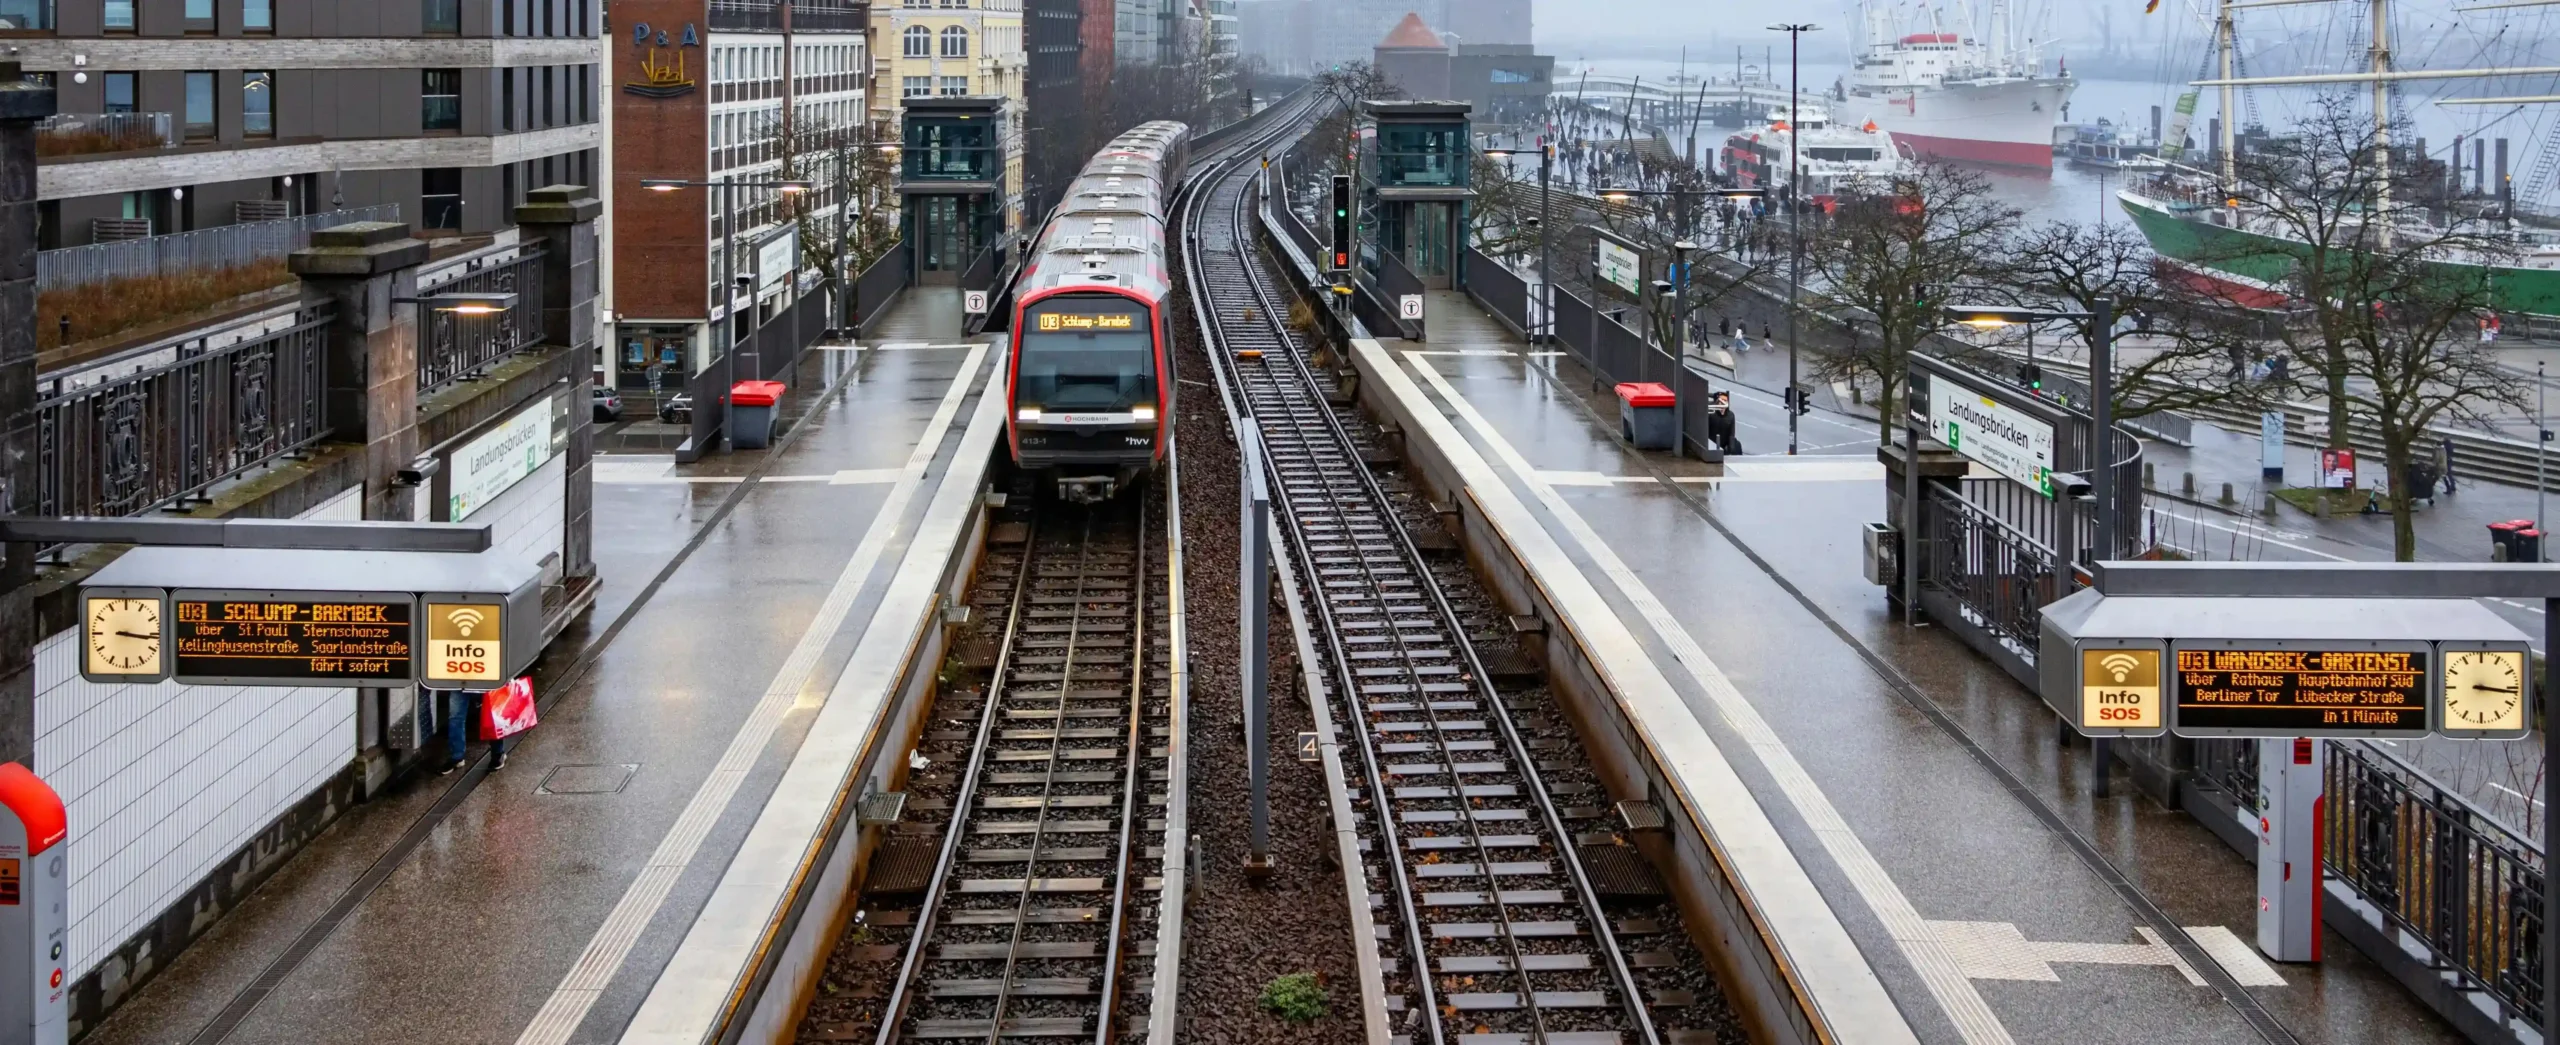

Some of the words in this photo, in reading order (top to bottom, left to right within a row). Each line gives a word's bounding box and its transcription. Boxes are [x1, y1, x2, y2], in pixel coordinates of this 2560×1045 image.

[633, 22, 651, 45] P
[656, 29, 669, 46] &
[681, 23, 699, 47] A
[1948, 395, 2029, 449] Landungsbrücken
[1022, 437, 1047, 445] 413-1
[1130, 437, 1150, 446] hvv
[470, 423, 536, 476] Landungsbrücken
[180, 604, 206, 619] U3
[303, 623, 389, 637] Sternschanze
[178, 638, 299, 653] Kellinghusenstraße
[311, 641, 408, 654] Saarlandstraße
[446, 644, 485, 658] Info
[310, 658, 343, 672] fährt
[348, 659, 389, 672] sofort
[446, 661, 485, 673] SOS
[2180, 652, 2207, 670] U3
[2231, 673, 2283, 686] Rathaus
[2099, 690, 2140, 704] Info
[2196, 689, 2252, 702] Berliner
[2257, 690, 2280, 702] Tor
[2295, 690, 2356, 703] Lübecker
[2360, 691, 2405, 704] Straße
[2099, 707, 2141, 720] SOS
[2323, 710, 2338, 723] in
[2341, 710, 2349, 723] 1
[2353, 710, 2398, 723] Minute
[1302, 737, 1317, 756] 4
